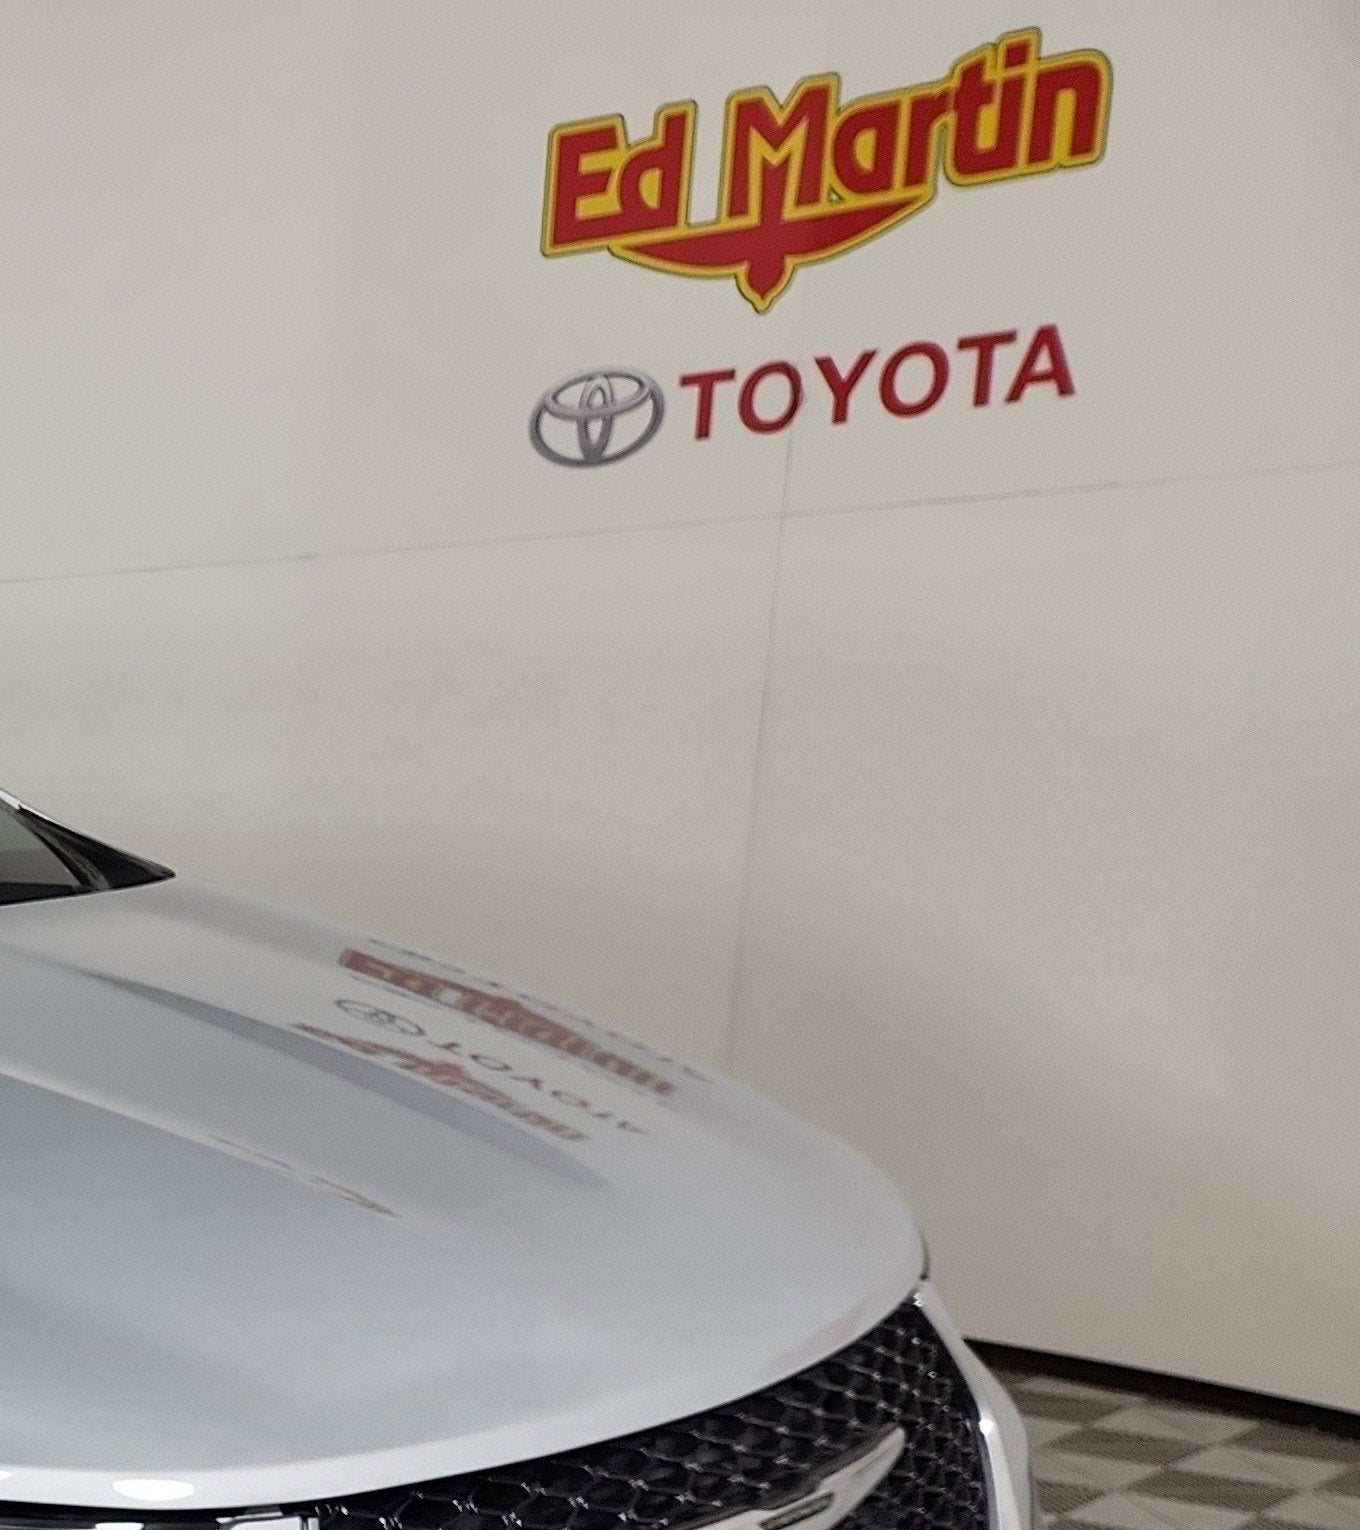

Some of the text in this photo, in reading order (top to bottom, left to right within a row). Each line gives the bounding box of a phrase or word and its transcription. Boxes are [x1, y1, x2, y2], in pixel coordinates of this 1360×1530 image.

[541, 27, 1113, 257] Ed Martin
[679, 323, 1076, 441] TOYOTA
